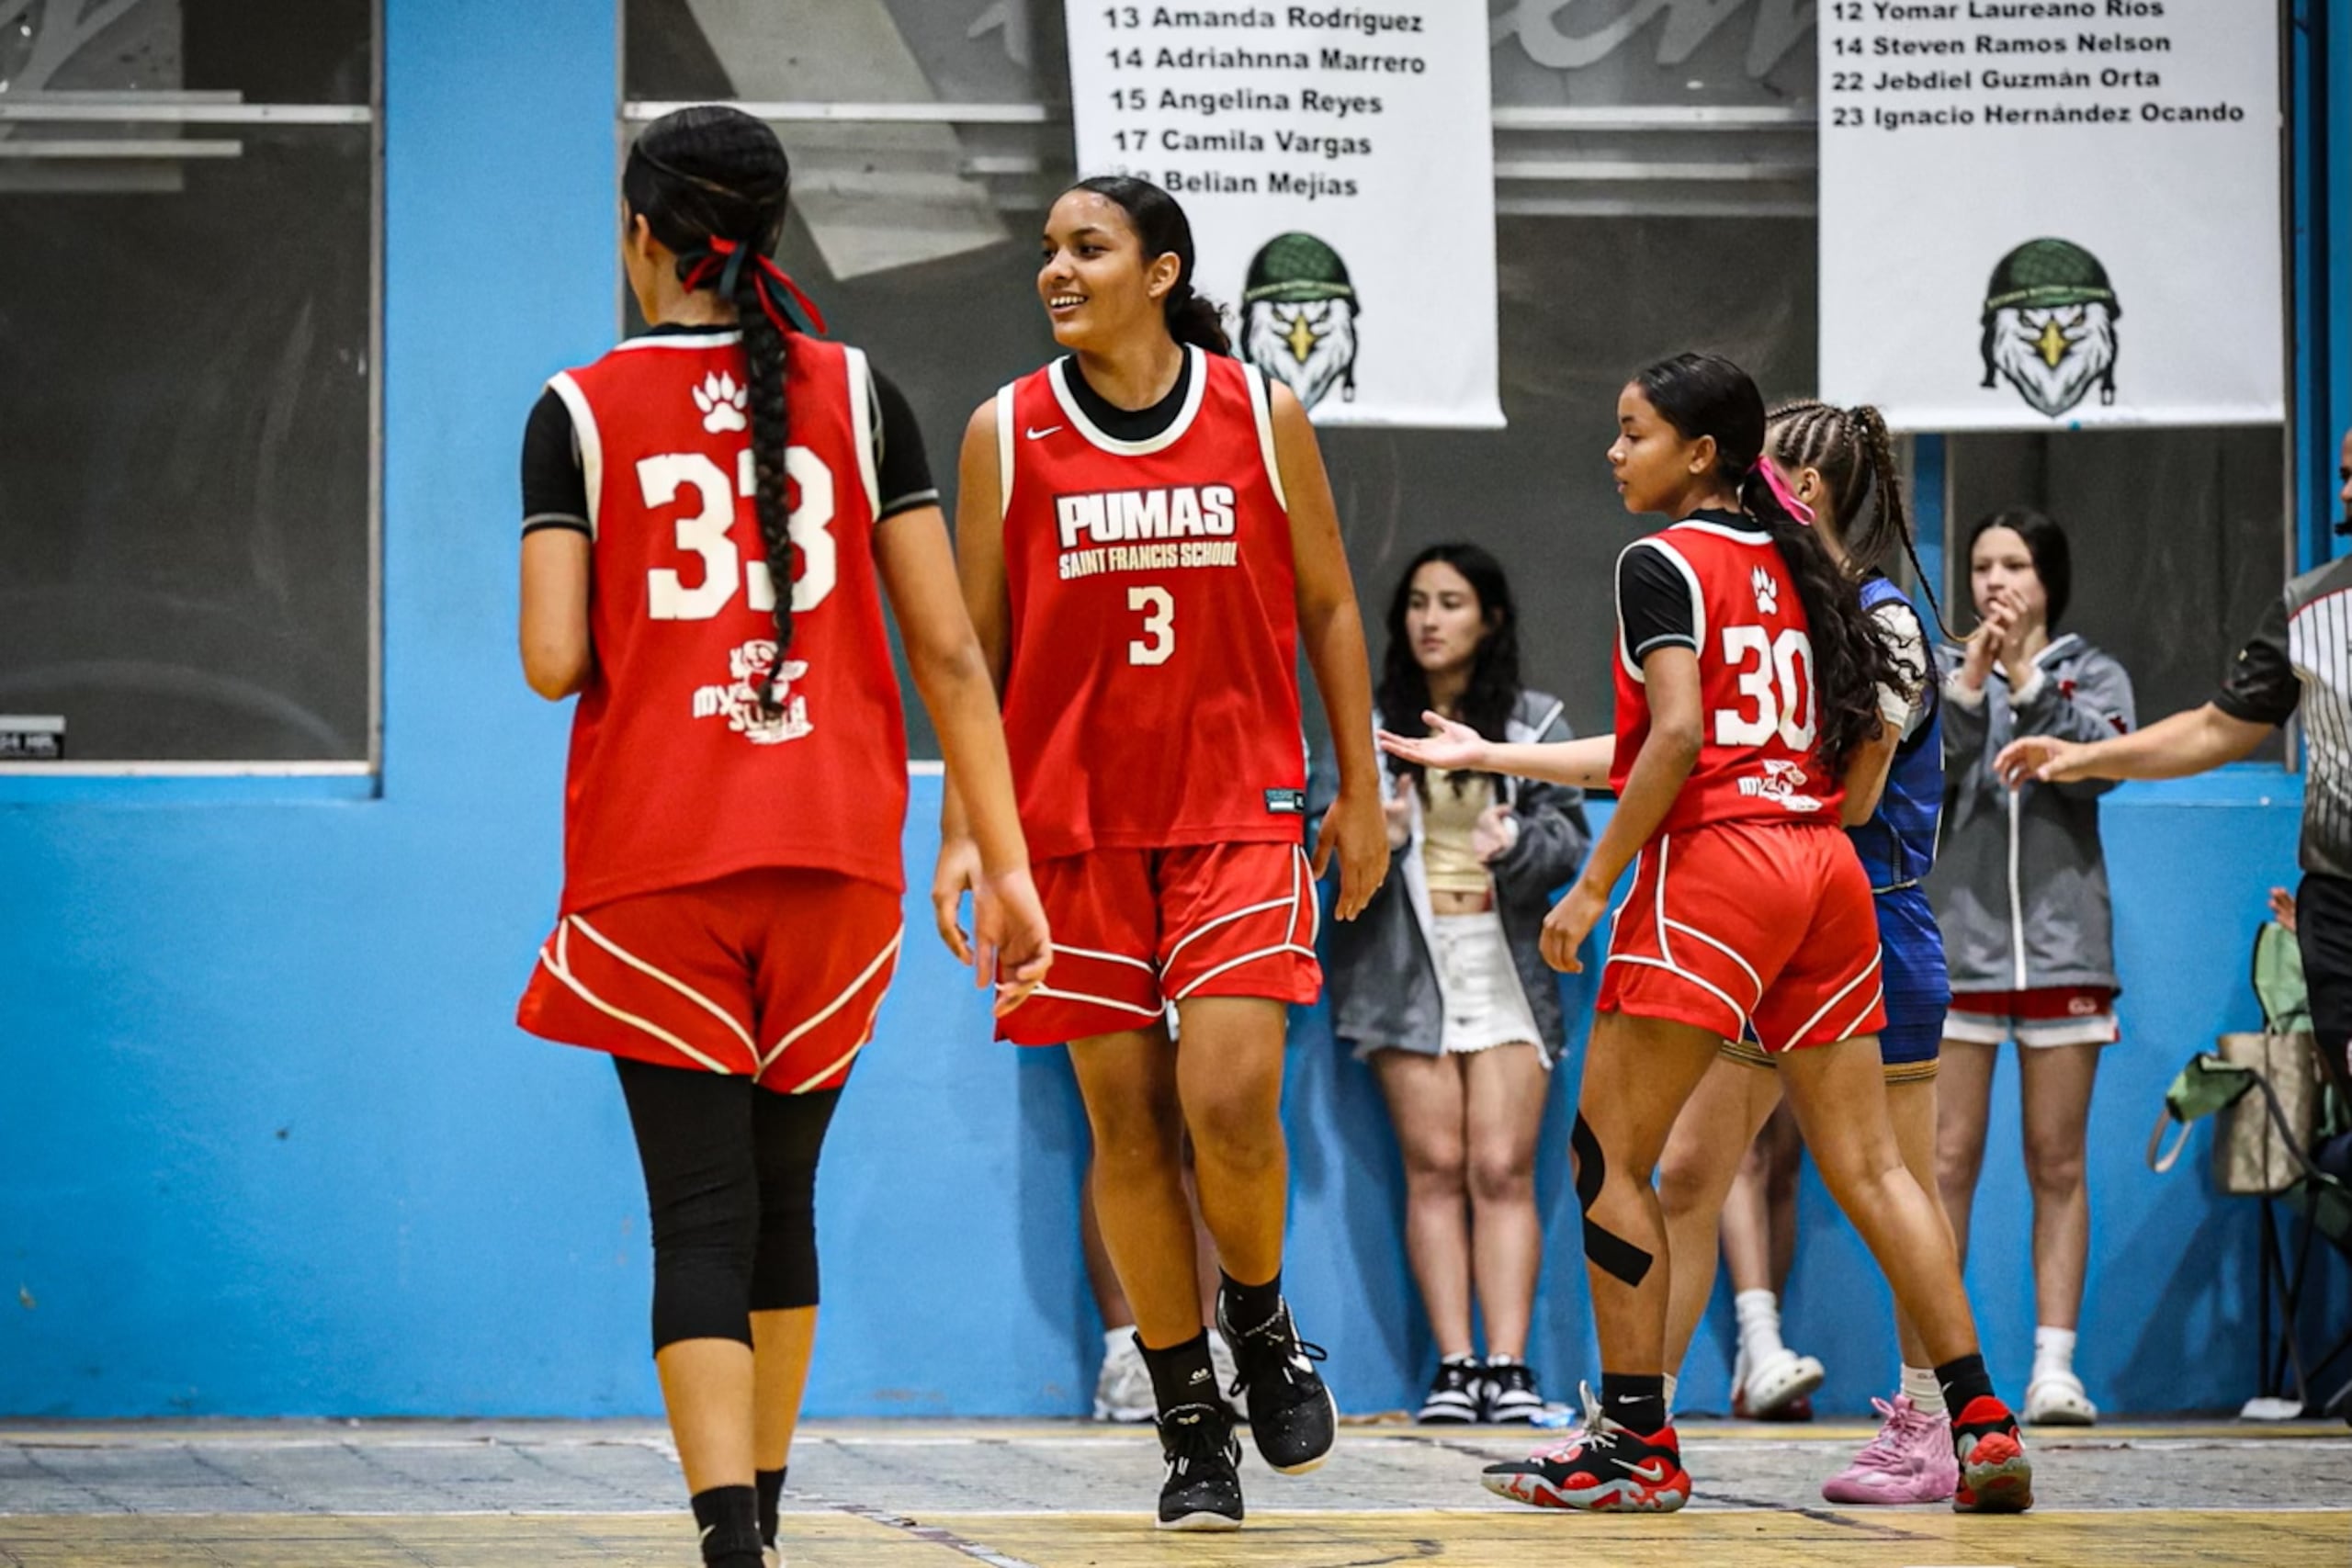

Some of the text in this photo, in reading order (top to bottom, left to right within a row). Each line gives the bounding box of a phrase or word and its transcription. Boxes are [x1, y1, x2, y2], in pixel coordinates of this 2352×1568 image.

[1104, 6, 1141, 28] 13
[1152, 6, 1276, 28] Amanda
[1832, 1, 1863, 21] 12
[1872, 1, 1960, 21] Yomar
[1968, 0, 2097, 20] Laureano
[1832, 32, 2173, 56] 14 Steven Ramos Nelson
[1107, 47, 1426, 74] 14 Adriahnna Marrero
[1832, 67, 2162, 91] 22 Jebdiel Guzmán Orta
[1111, 88, 1384, 118] 15 Angelina Reyes
[1832, 101, 2246, 132] 23 Ignacio Hernández Ocando
[1114, 130, 1373, 159] 17 Camila Vargas
[1163, 171, 1258, 193] Belian
[1056, 485, 1237, 549] PUMAS
[636, 446, 838, 620] 33
[1058, 540, 1238, 581] SAINT FRANCIS SCHOOL
[1127, 585, 1175, 666] 3
[1714, 625, 1816, 751] 30
